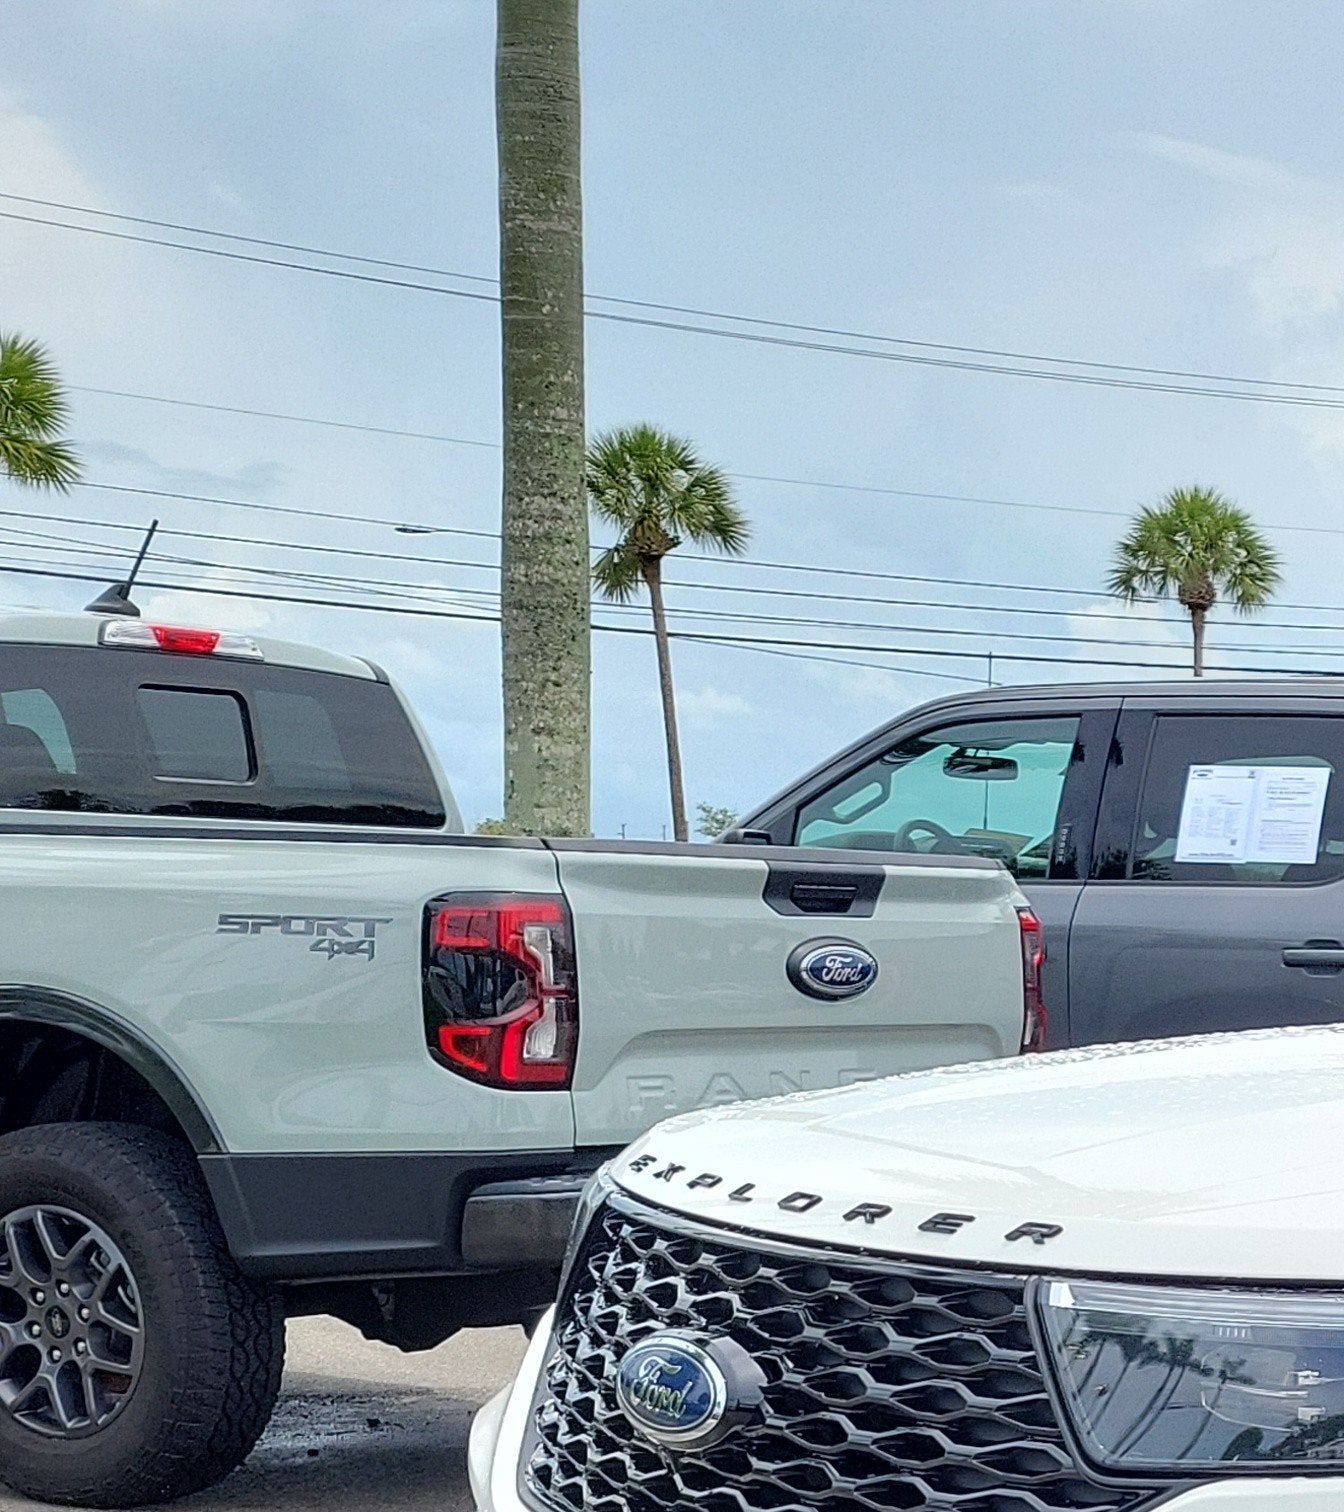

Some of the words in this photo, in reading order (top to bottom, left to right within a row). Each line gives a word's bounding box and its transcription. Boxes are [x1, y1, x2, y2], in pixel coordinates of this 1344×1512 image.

[215, 914, 394, 938] SPORT
[821, 955, 863, 982] Ford
[629, 1153, 1064, 1245] EXPLORER
[629, 1356, 693, 1418] Ford
